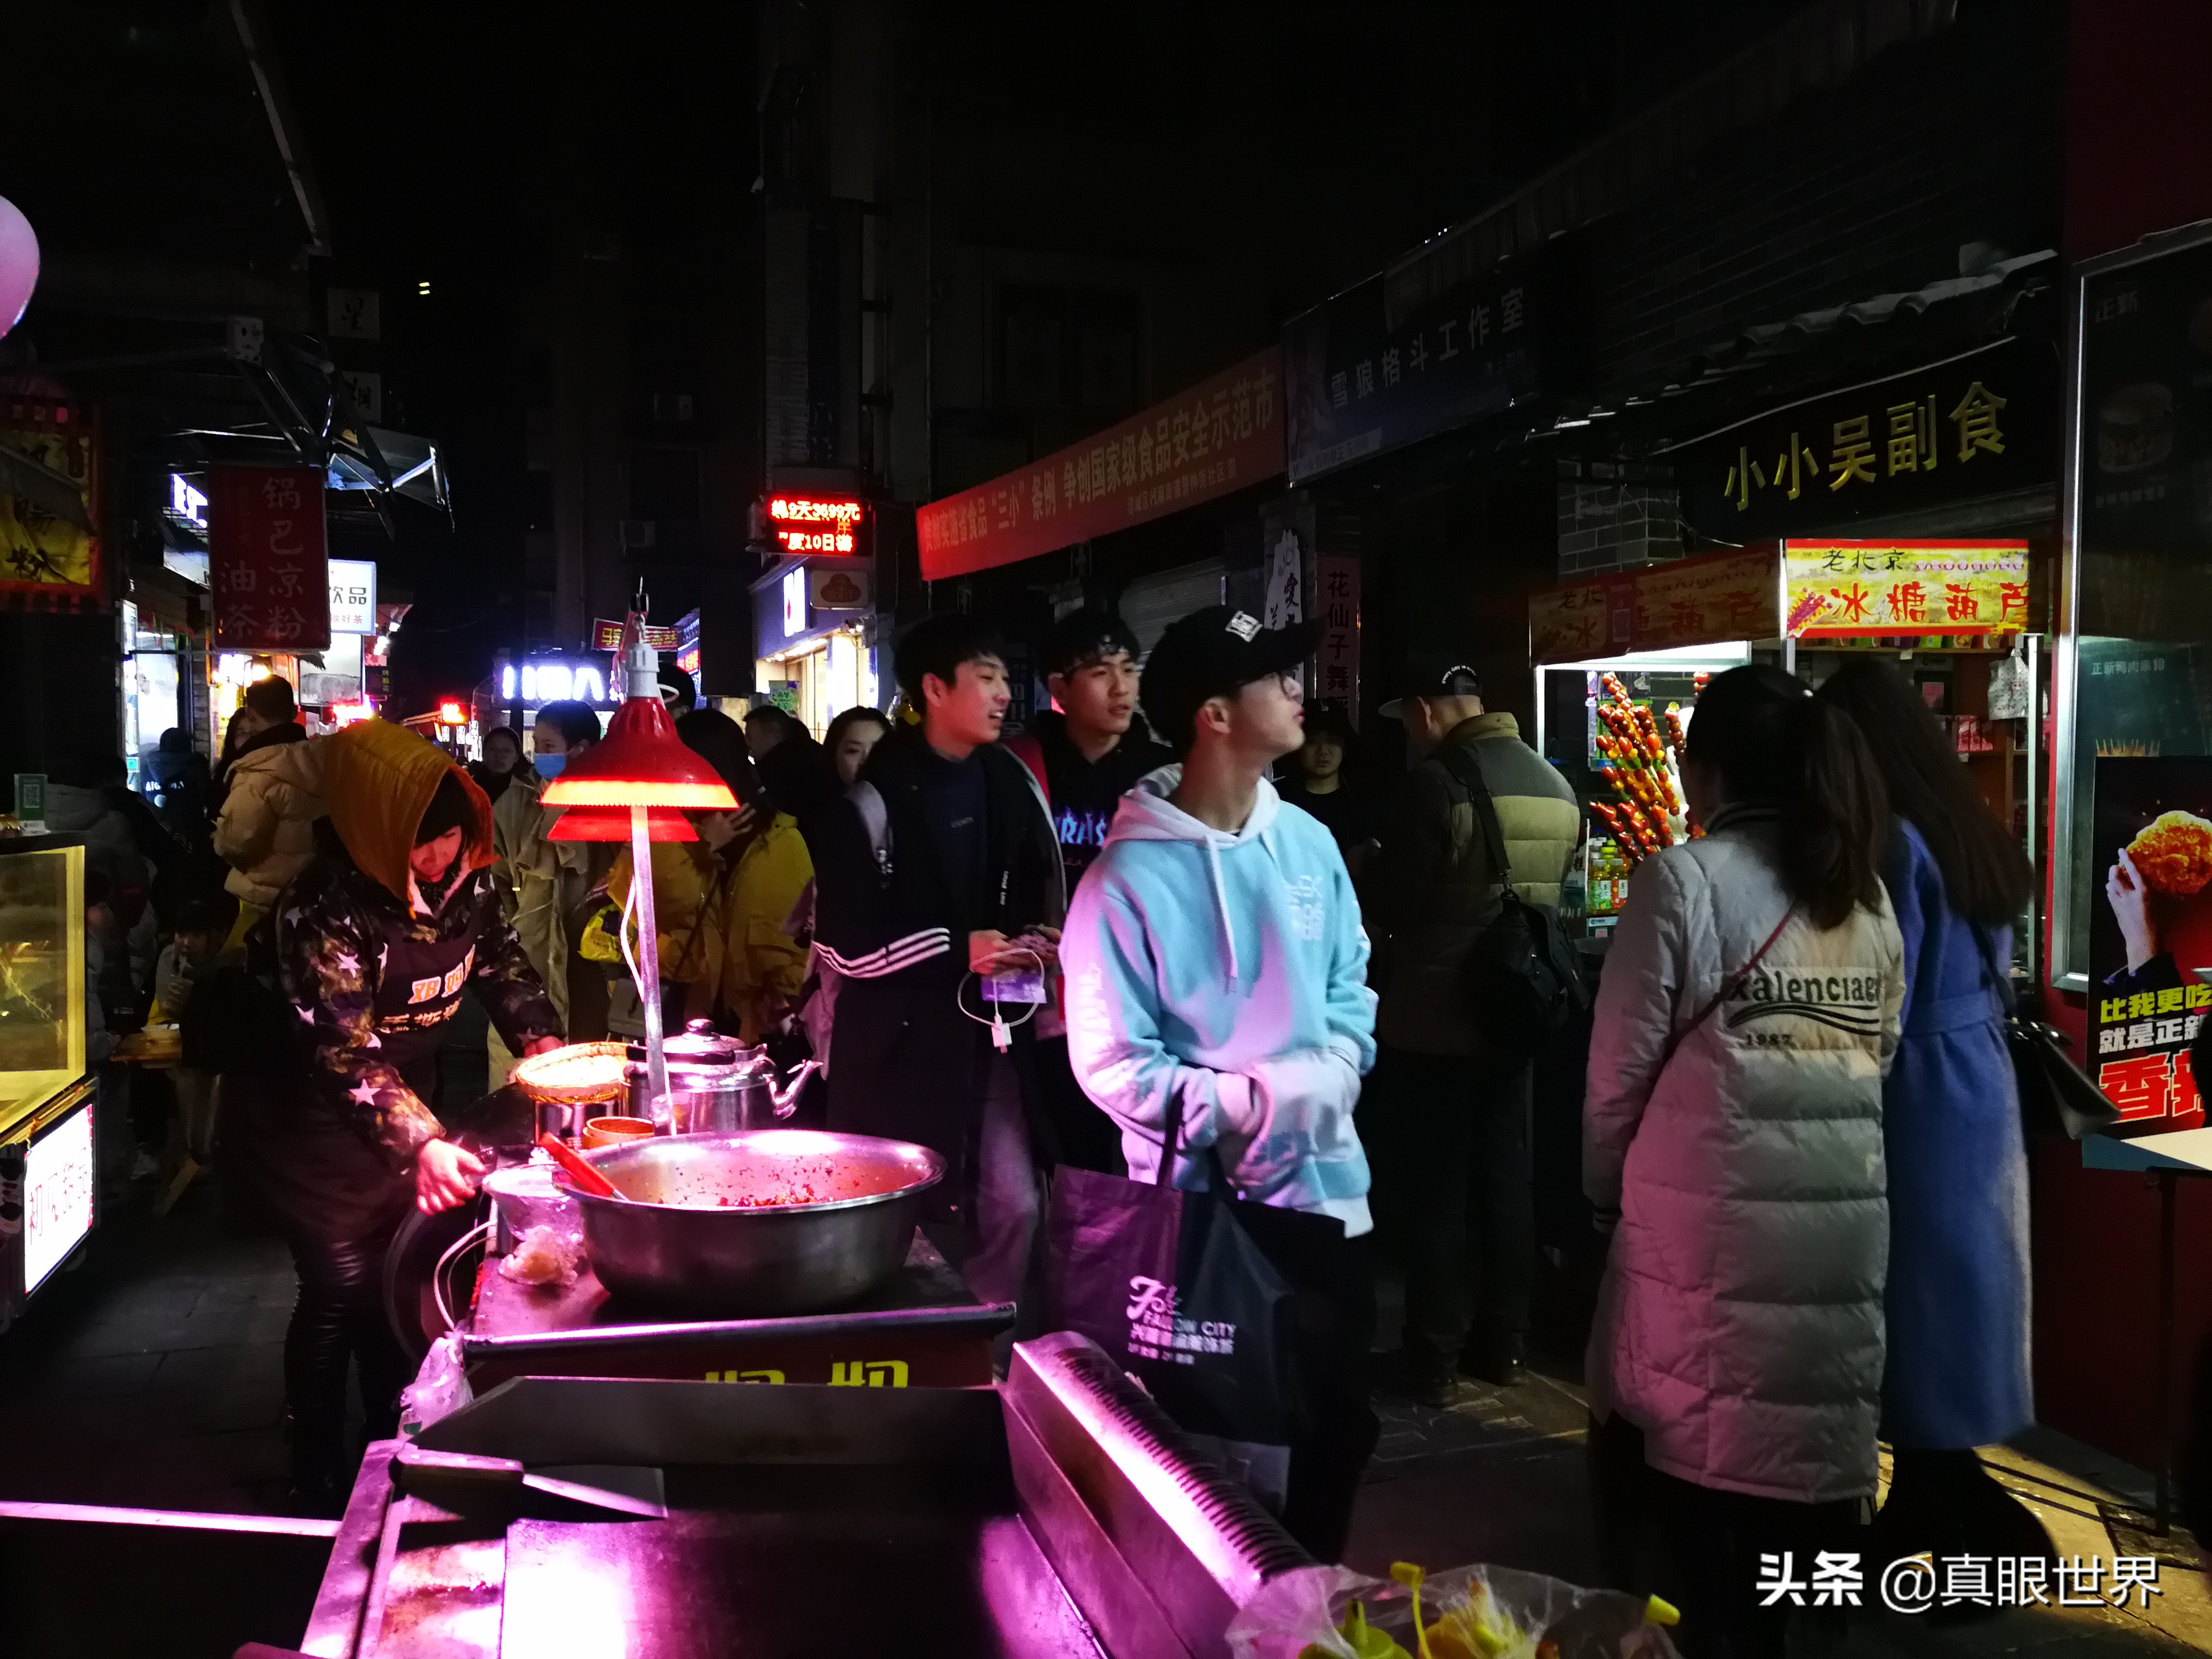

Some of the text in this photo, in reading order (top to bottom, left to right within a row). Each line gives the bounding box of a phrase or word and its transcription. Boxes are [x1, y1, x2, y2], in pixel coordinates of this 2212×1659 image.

[1331, 287, 1524, 409] 雪狼格斗工作室
[1723, 381, 2008, 512] 小小吴副食
[221, 560, 261, 641] 油茶
[262, 476, 307, 641] 锅巴凉粉
[1821, 548, 1905, 572] 老北京
[1830, 580, 2028, 623] 冰糖葫芦
